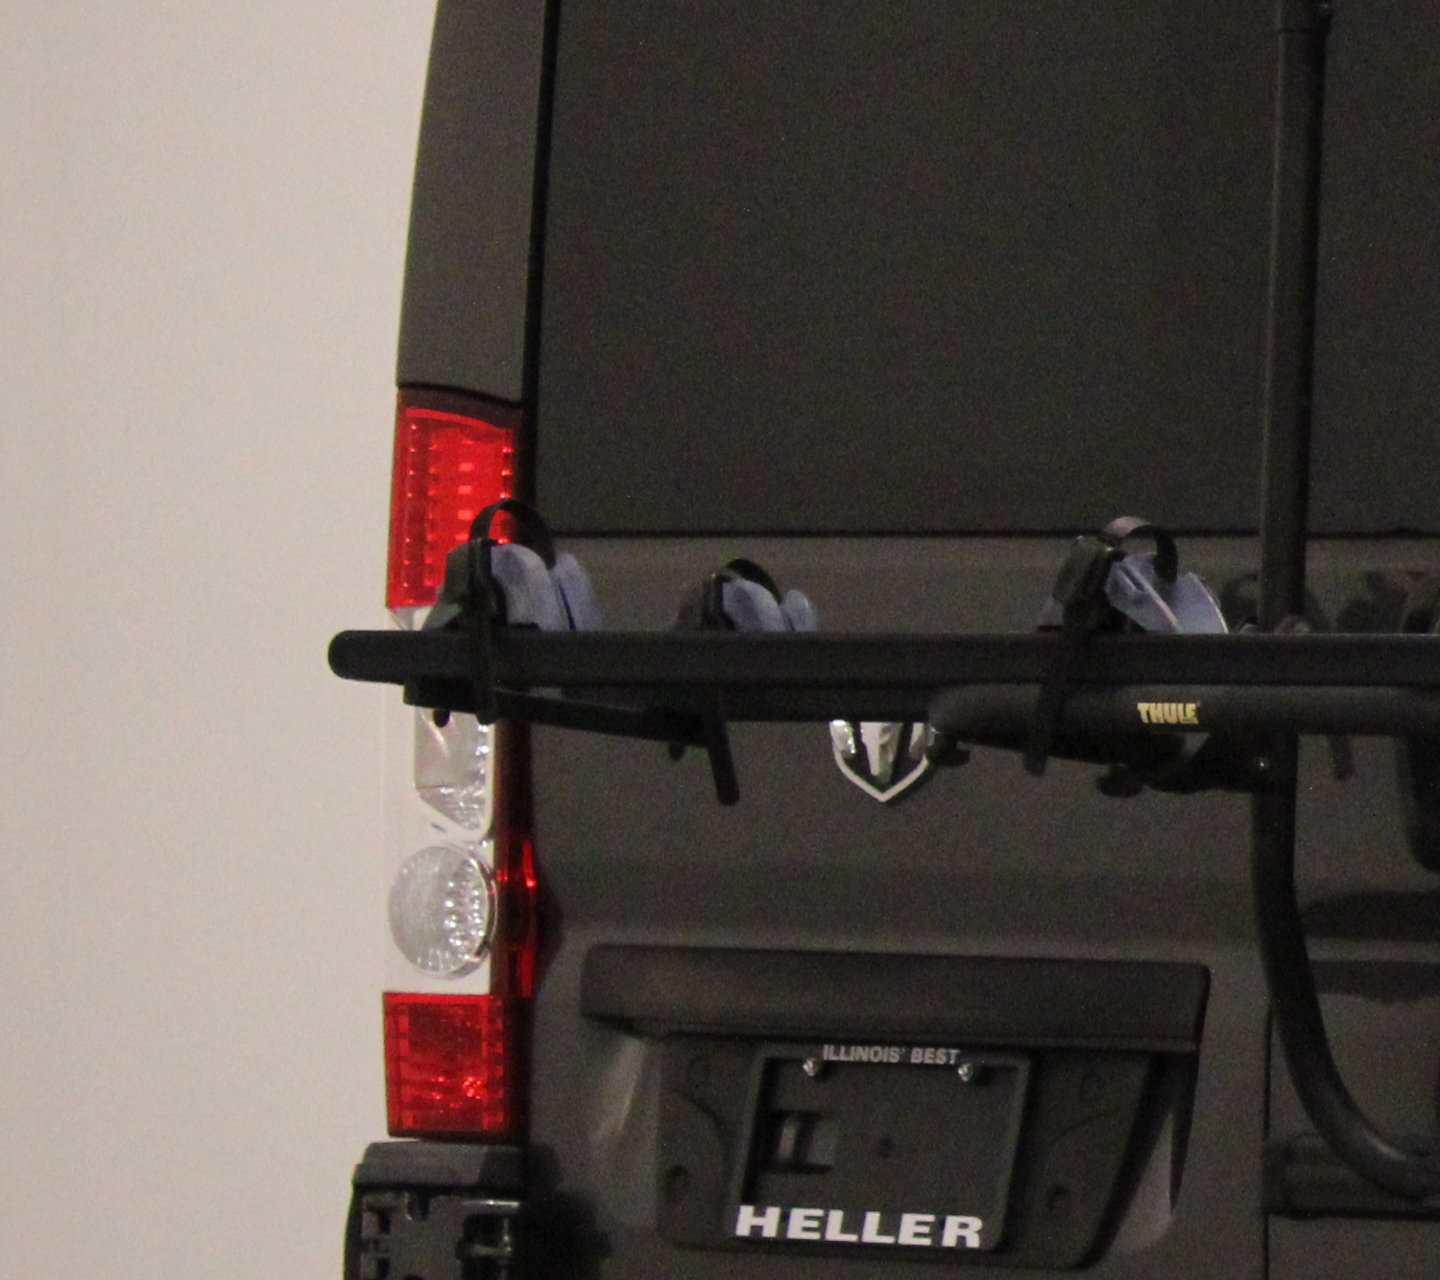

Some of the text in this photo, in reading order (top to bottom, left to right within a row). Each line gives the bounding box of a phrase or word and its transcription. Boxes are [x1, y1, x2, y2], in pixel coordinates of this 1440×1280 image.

[1137, 702, 1199, 724] THULE
[910, 1047, 960, 1065] BEST
[735, 1205, 983, 1248] HELLER
